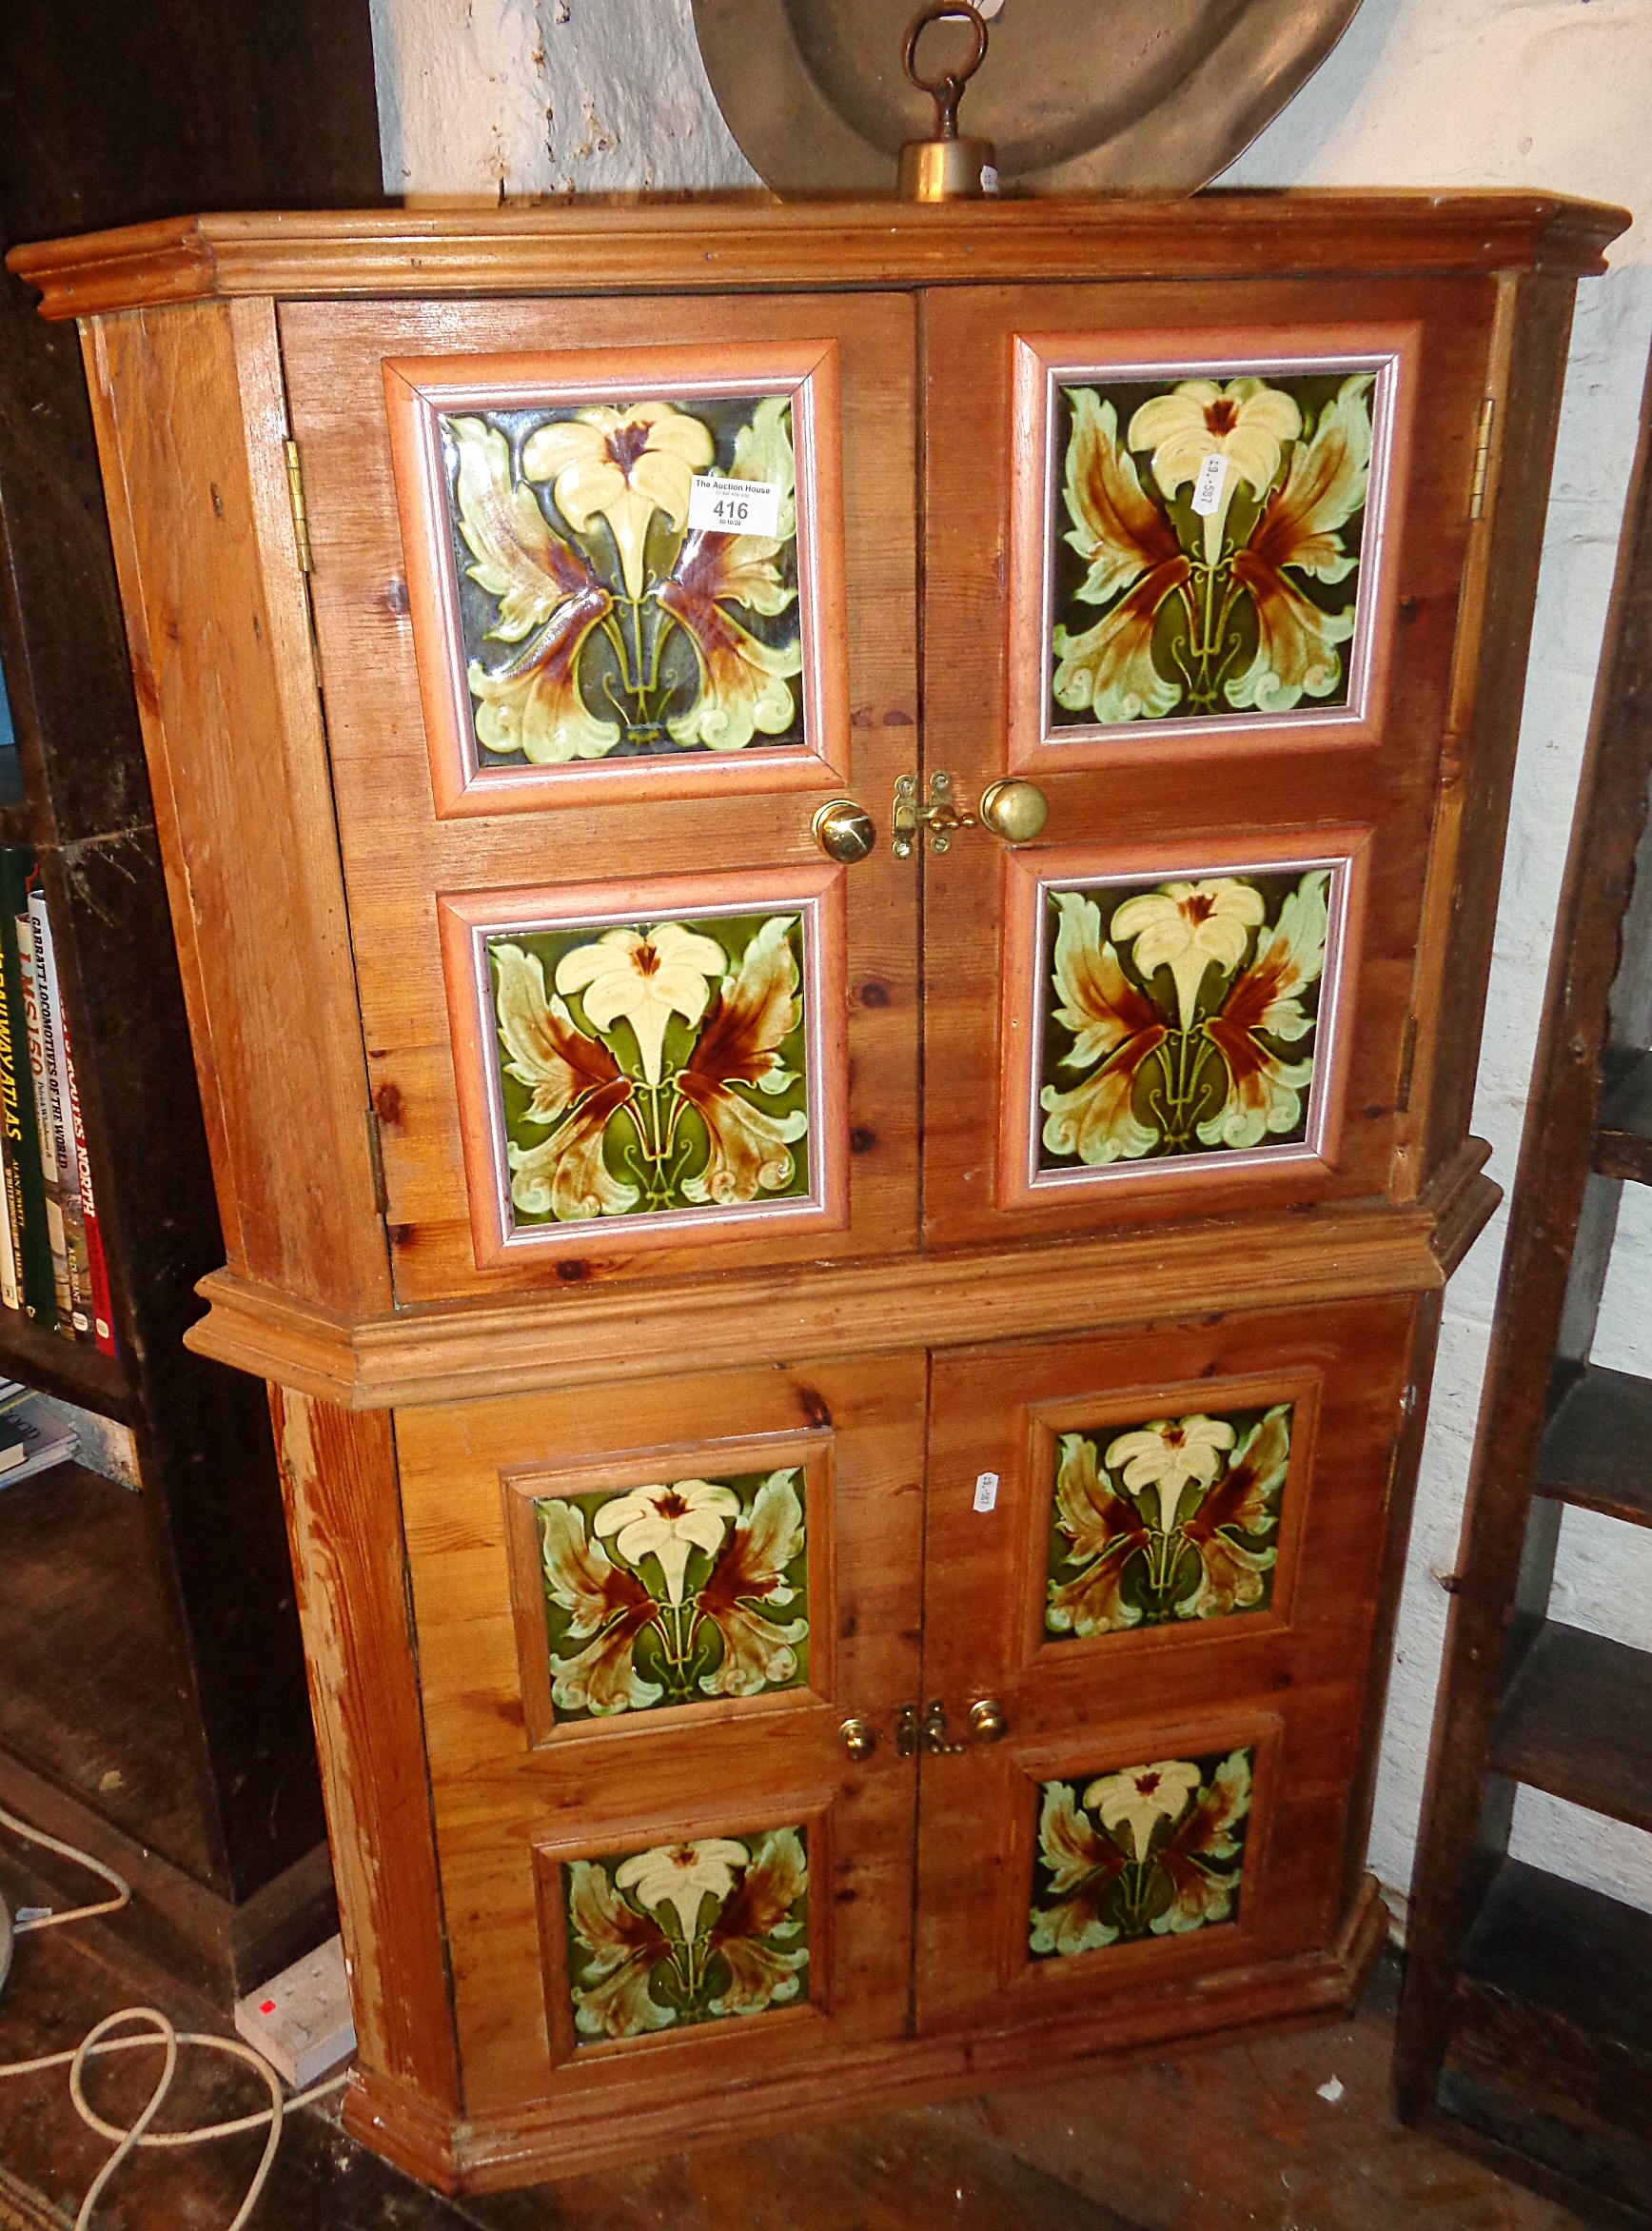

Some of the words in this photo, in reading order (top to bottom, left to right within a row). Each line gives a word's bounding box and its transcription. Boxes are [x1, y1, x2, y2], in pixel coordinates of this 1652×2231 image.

[713, 482, 743, 491] Auction
[745, 484, 771, 494] House
[713, 500, 748, 520] 416
[31, 916, 47, 981] GARRATT
[39, 983, 57, 1076] LOCOMOTIVES
[1, 1067, 22, 1140] ATLAS
[49, 1077, 59, 1095] OF
[51, 1096, 63, 1122] THE
[54, 1124, 69, 1170] WORLD
[76, 1145, 95, 1217] NORTH
